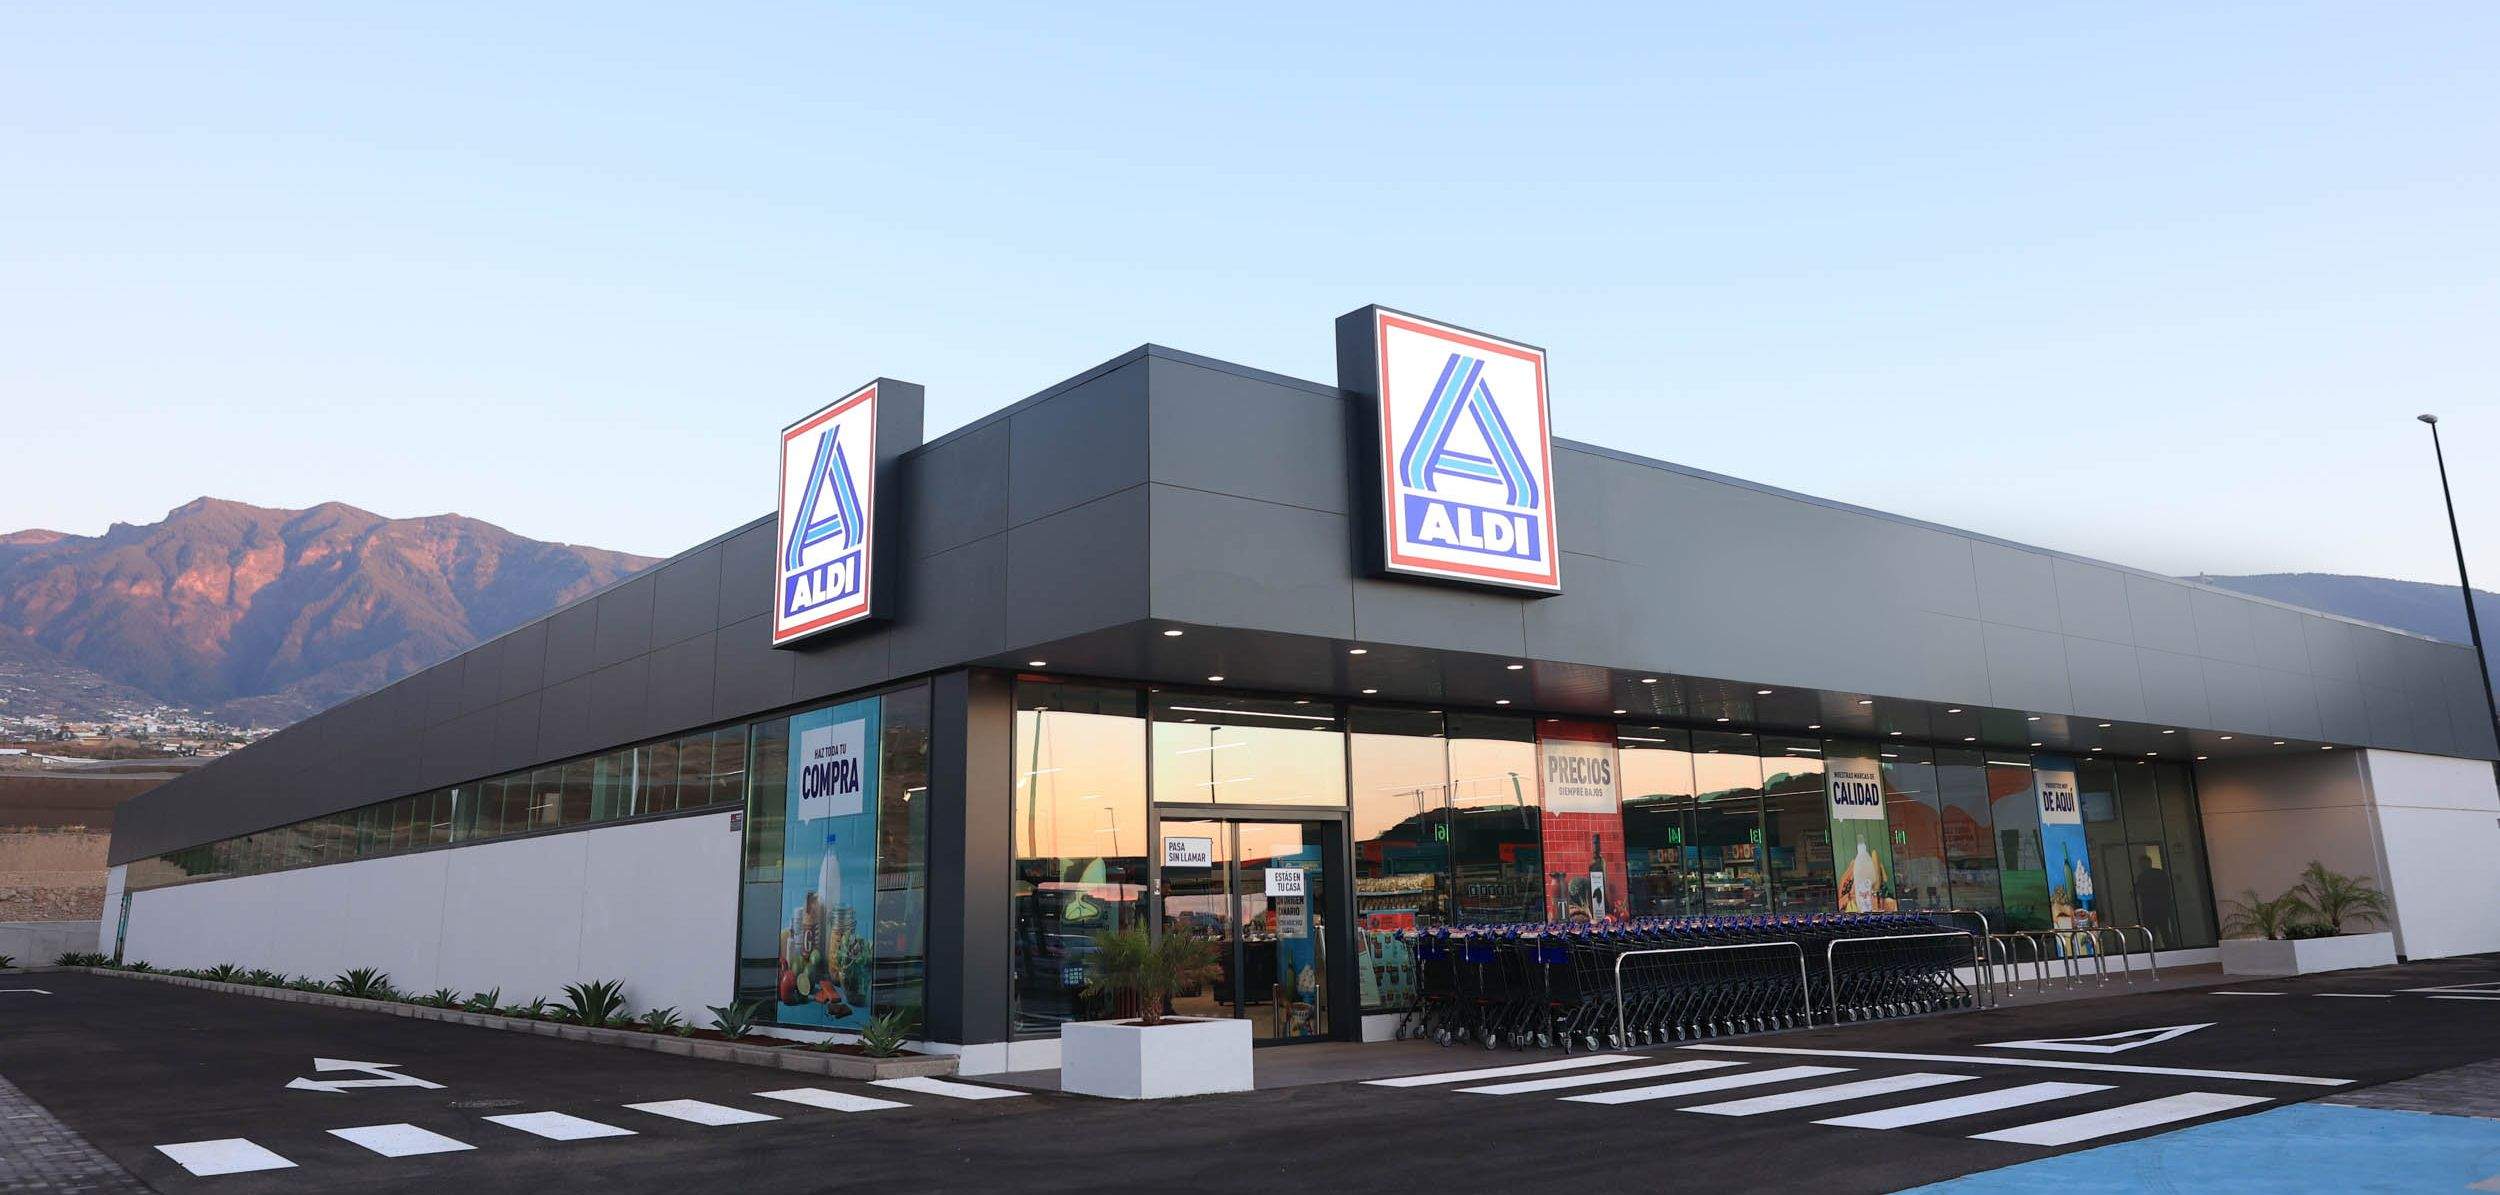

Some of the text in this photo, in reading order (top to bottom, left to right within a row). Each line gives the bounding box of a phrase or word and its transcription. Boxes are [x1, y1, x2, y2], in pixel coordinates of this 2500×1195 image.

[1417, 502, 1530, 556] ALDI
[790, 556, 855, 612] ALDI
[814, 743, 847, 759] HAZ TODA TU
[802, 757, 859, 800] COMPRA
[1548, 755, 1611, 785] PRECIOS
[1559, 786, 1603, 797] SIEMPRE BAJOS
[1833, 781, 1879, 806] CALIDAD
[2042, 787, 2075, 812] DE AQUÍ
[1168, 842, 1186, 852] PASA
[1168, 852, 1206, 862] SIN LLAMAR
[1275, 871, 1301, 882] ESTÁS EN
[1277, 882, 1301, 892] TU CASA
